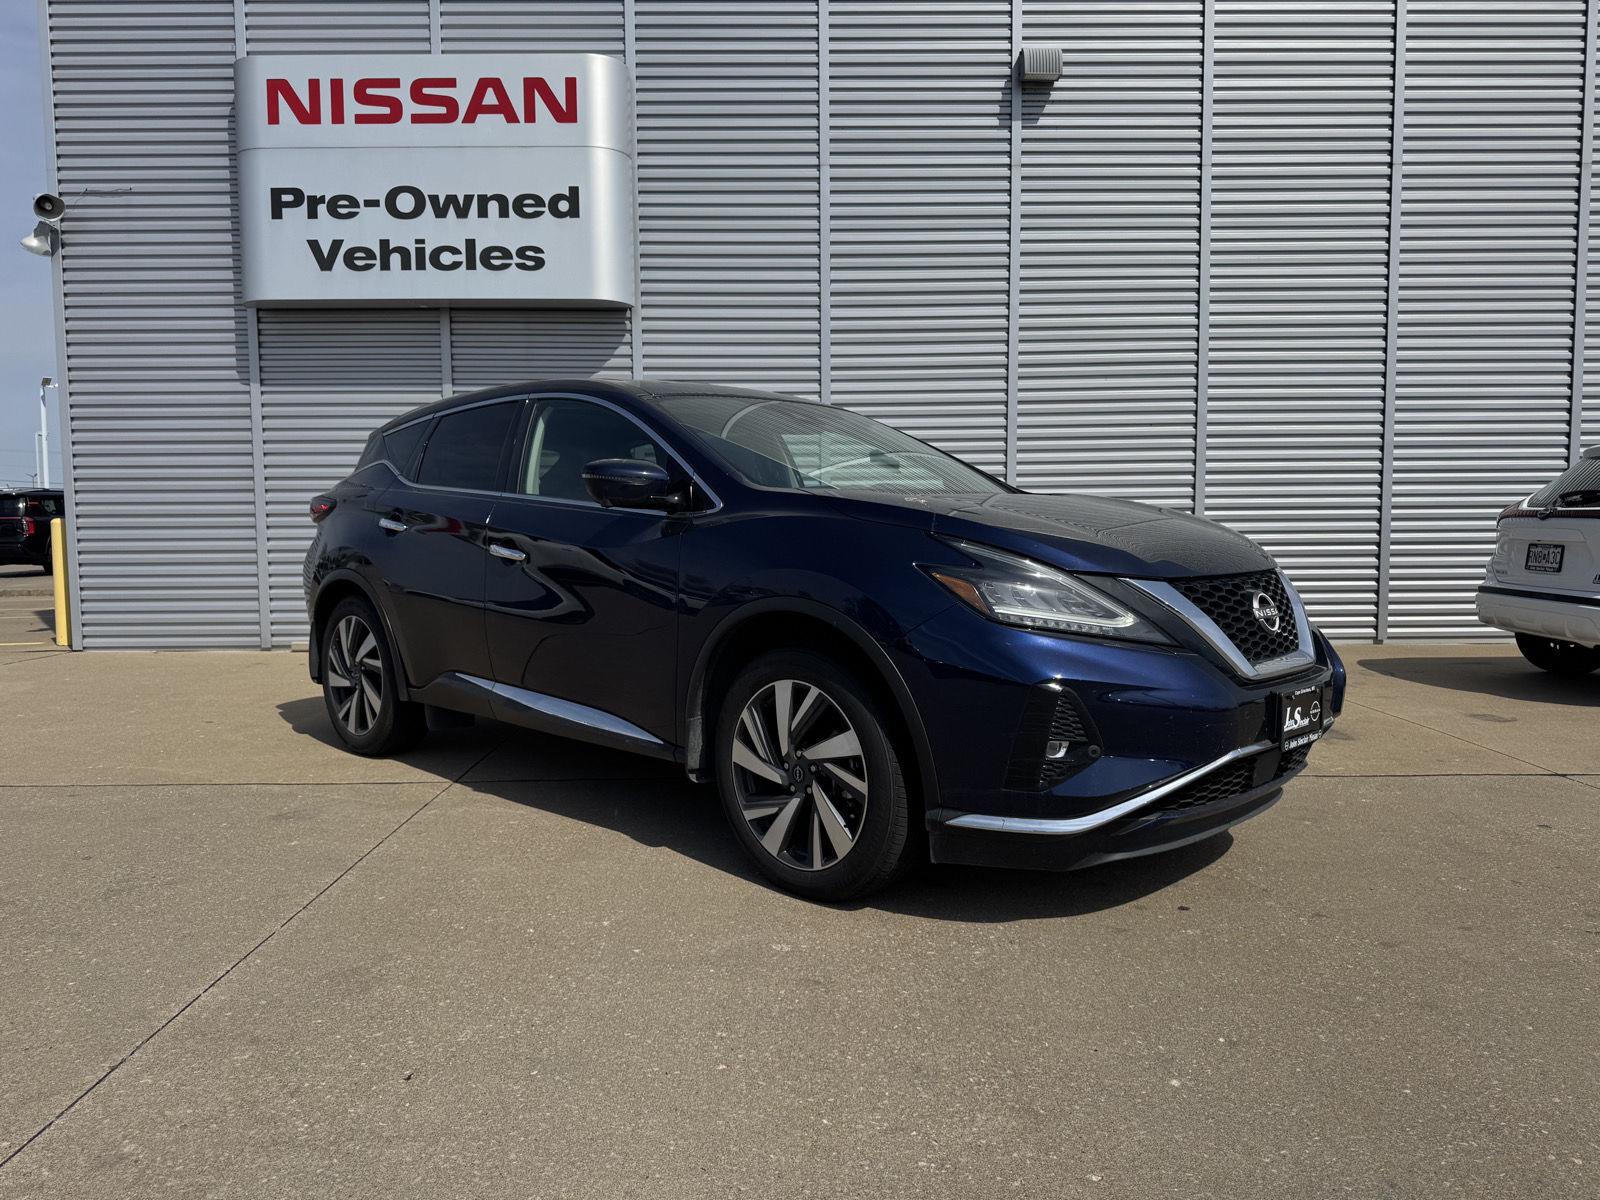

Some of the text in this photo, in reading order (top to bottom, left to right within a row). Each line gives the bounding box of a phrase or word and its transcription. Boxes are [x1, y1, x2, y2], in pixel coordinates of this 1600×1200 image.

[266, 77, 578, 125] NISSAN
[269, 185, 580, 220] Pre-Owned
[306, 238, 546, 272] Vehicles
